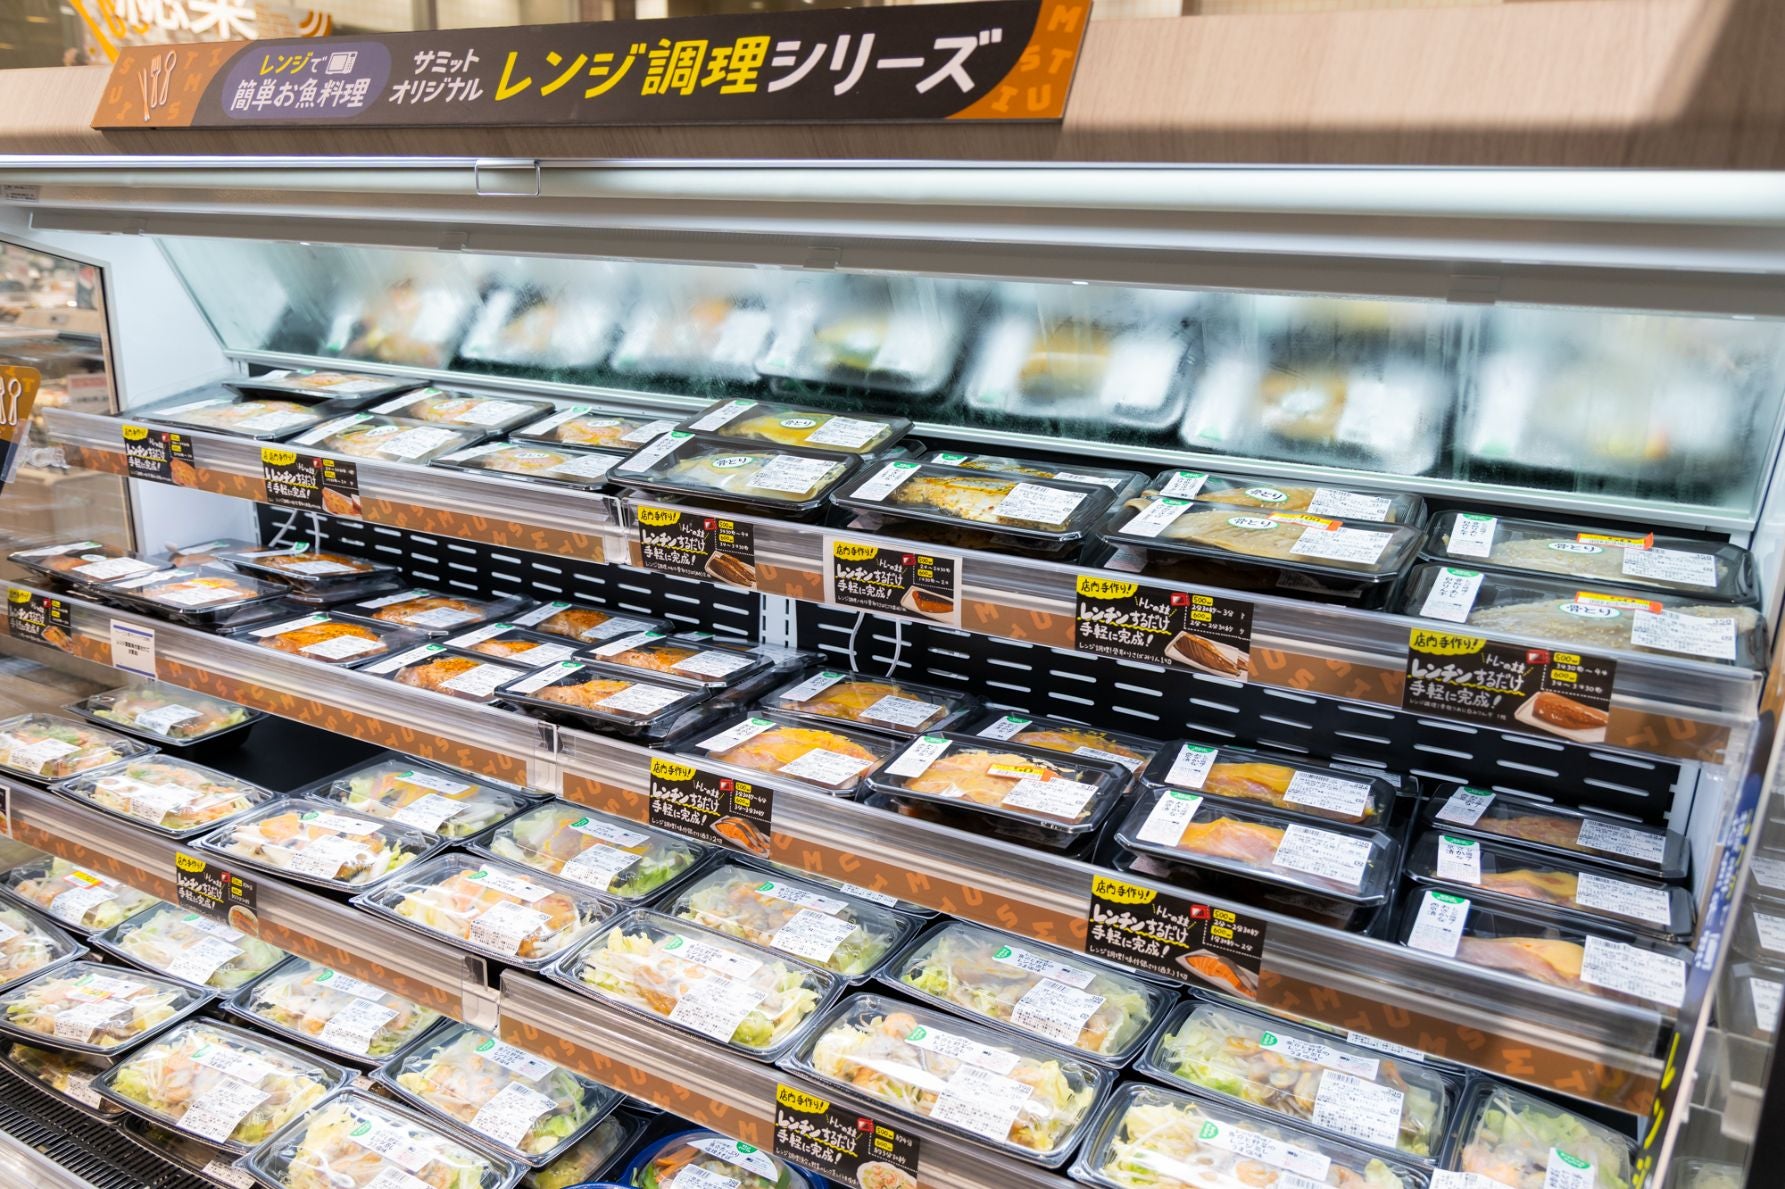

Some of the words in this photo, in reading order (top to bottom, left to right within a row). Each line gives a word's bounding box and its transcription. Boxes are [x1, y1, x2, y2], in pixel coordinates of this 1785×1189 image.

[259, 51, 327, 76] レンジで
[413, 47, 481, 75] サミット
[495, 28, 1003, 101] レンジ調理シリーズ
[230, 78, 371, 112] 簡単お魚料理
[388, 78, 484, 105] オリジナル
[641, 510, 677, 521] 店内手作り!
[642, 529, 706, 551] レンチンするだけ
[643, 546, 697, 566] 手軽に完成!
[837, 564, 904, 586] レンチンするだけ
[1081, 578, 1132, 595] 店内手作り!
[838, 580, 892, 600] 手軽に完成!
[1080, 602, 1171, 632] レンチンするだけ
[1139, 597, 1171, 615] トレーのまま
[1079, 621, 1154, 647] 手軽に完成!
[1414, 633, 1478, 650] 店内手作り!
[1411, 658, 1525, 691] レンチンするだけ
[1486, 655, 1526, 674] トレーのまま
[1409, 680, 1503, 709] 手軽に完成!
[654, 762, 692, 777] 店内手作り!
[651, 782, 720, 812] レンチンするだけ
[652, 799, 708, 826] 手軽に完成!
[1096, 881, 1150, 900] 店内手作り!
[1093, 903, 1189, 943] レンチンするだけ
[1156, 905, 1190, 927] トレーのまま
[1091, 925, 1171, 958] 手軽に完成!
[779, 1089, 824, 1110] 店内手作り!
[777, 1110, 857, 1152] レンチンするだけ
[776, 1129, 843, 1164] 手軽に完成!
